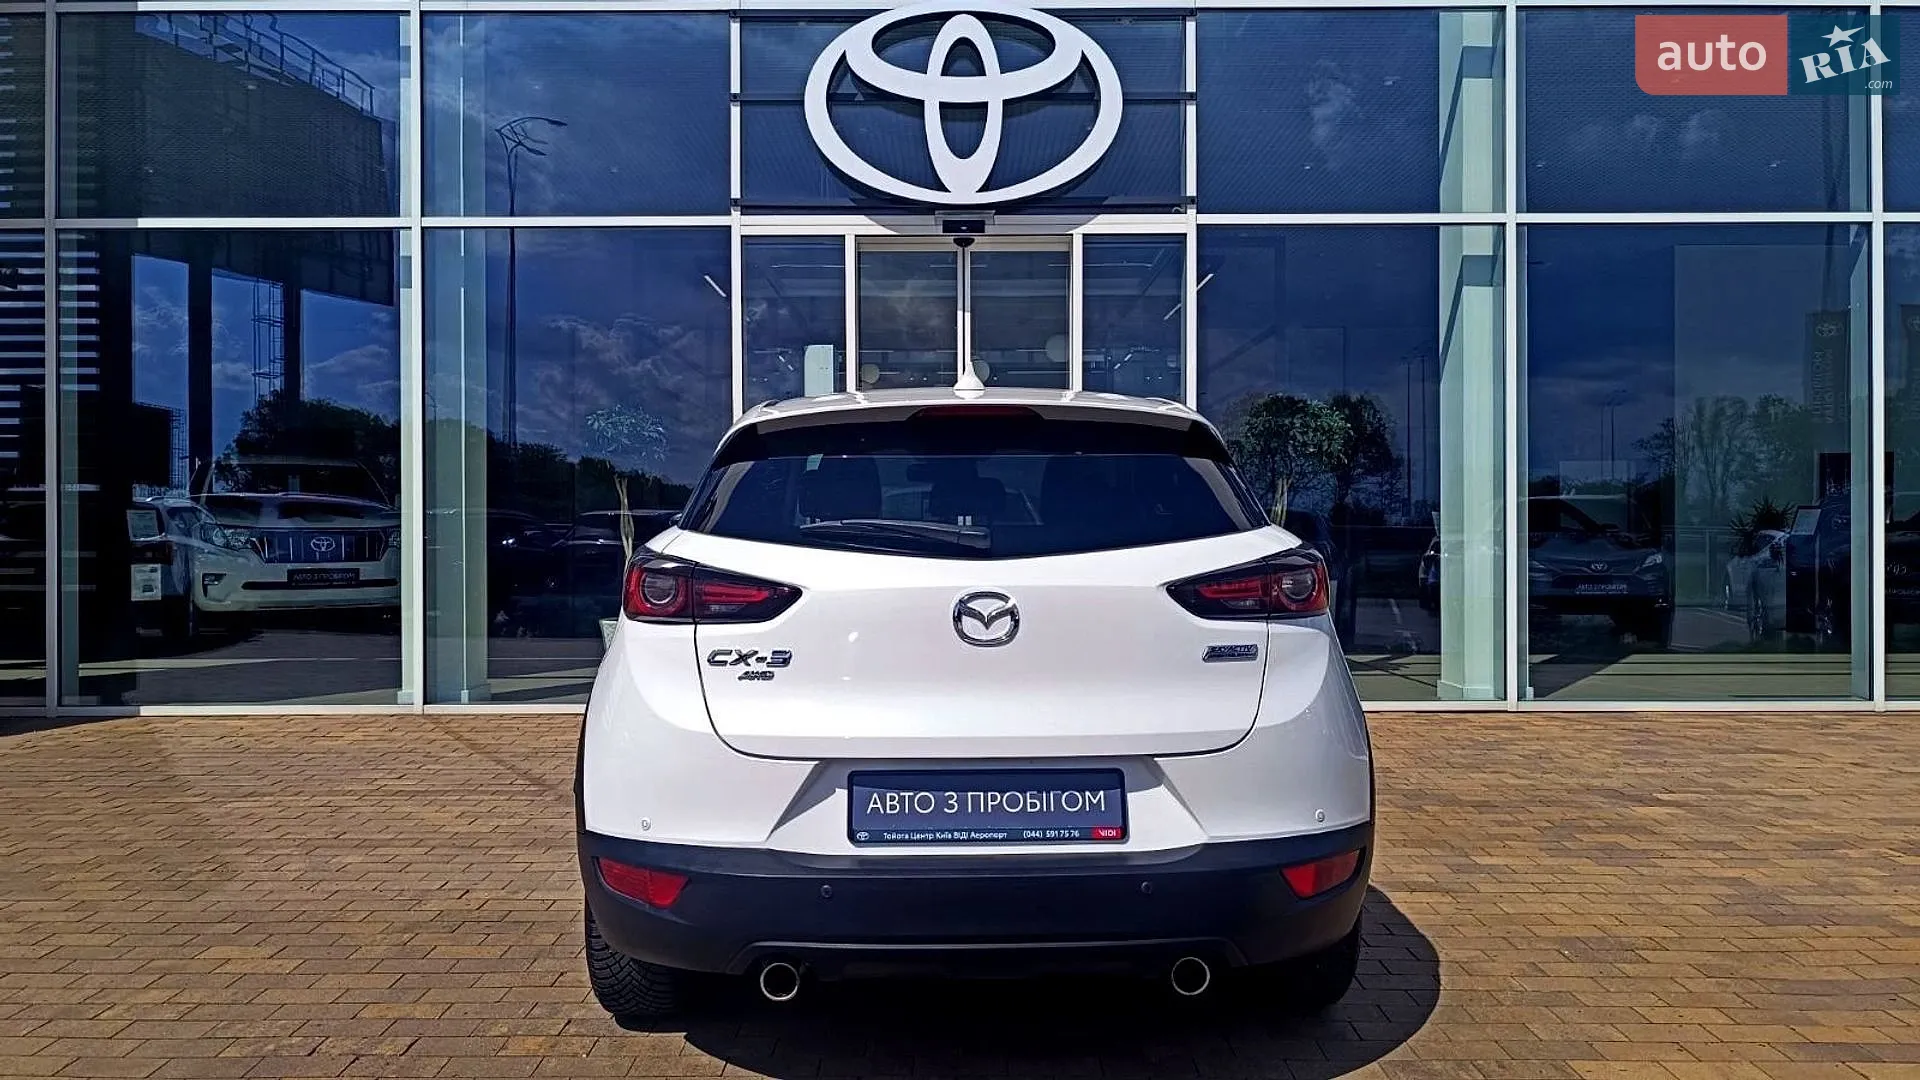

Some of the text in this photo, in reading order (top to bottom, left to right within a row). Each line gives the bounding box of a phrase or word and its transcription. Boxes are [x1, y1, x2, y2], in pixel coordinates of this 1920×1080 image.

[707, 649, 793, 668] CX-3
[737, 670, 775, 681] AWD
[866, 791, 935, 814] АВТО
[967, 790, 1105, 813] ПРОБІГОМ
[883, 832, 908, 840] Тойота
[910, 832, 934, 841] Центр
[970, 831, 1008, 841] Аеропорт
[1023, 830, 1043, 839] (044)
[1098, 829, 1117, 837] VIDI
